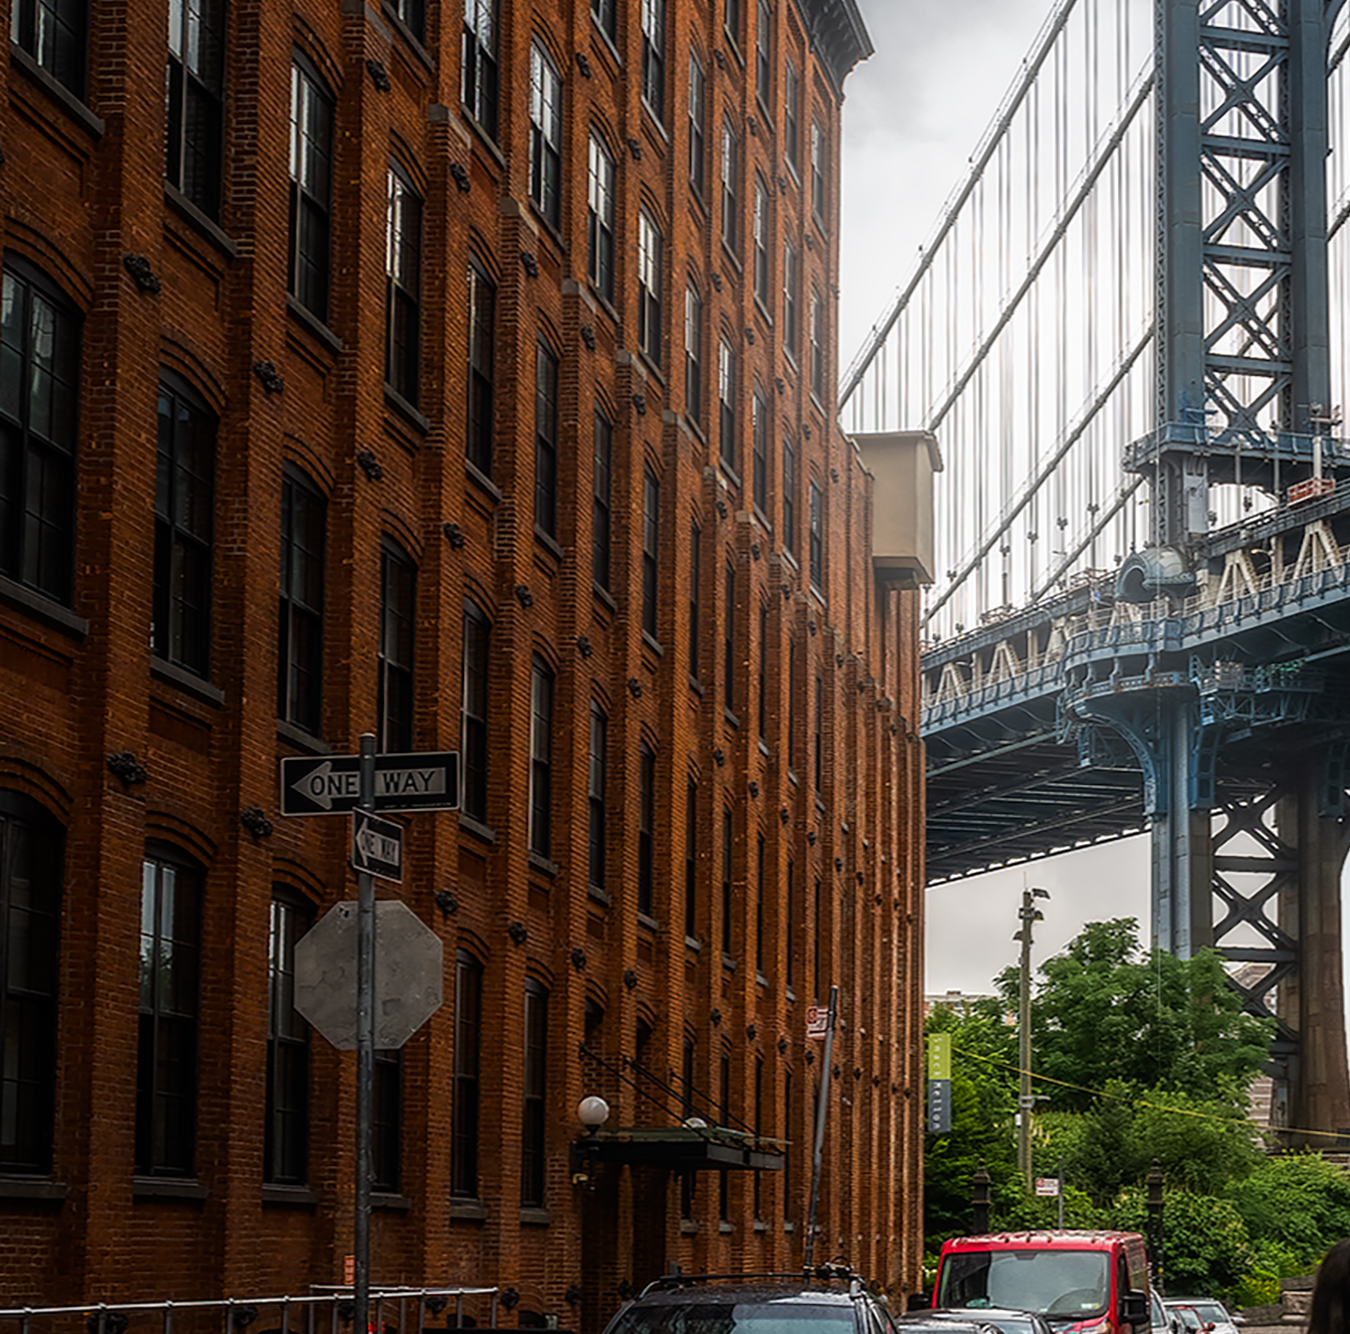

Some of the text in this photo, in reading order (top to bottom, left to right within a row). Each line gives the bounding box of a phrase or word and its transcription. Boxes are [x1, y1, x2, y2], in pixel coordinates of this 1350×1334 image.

[310, 771, 436, 796] ONE WAY
[359, 829, 375, 855] ONE
